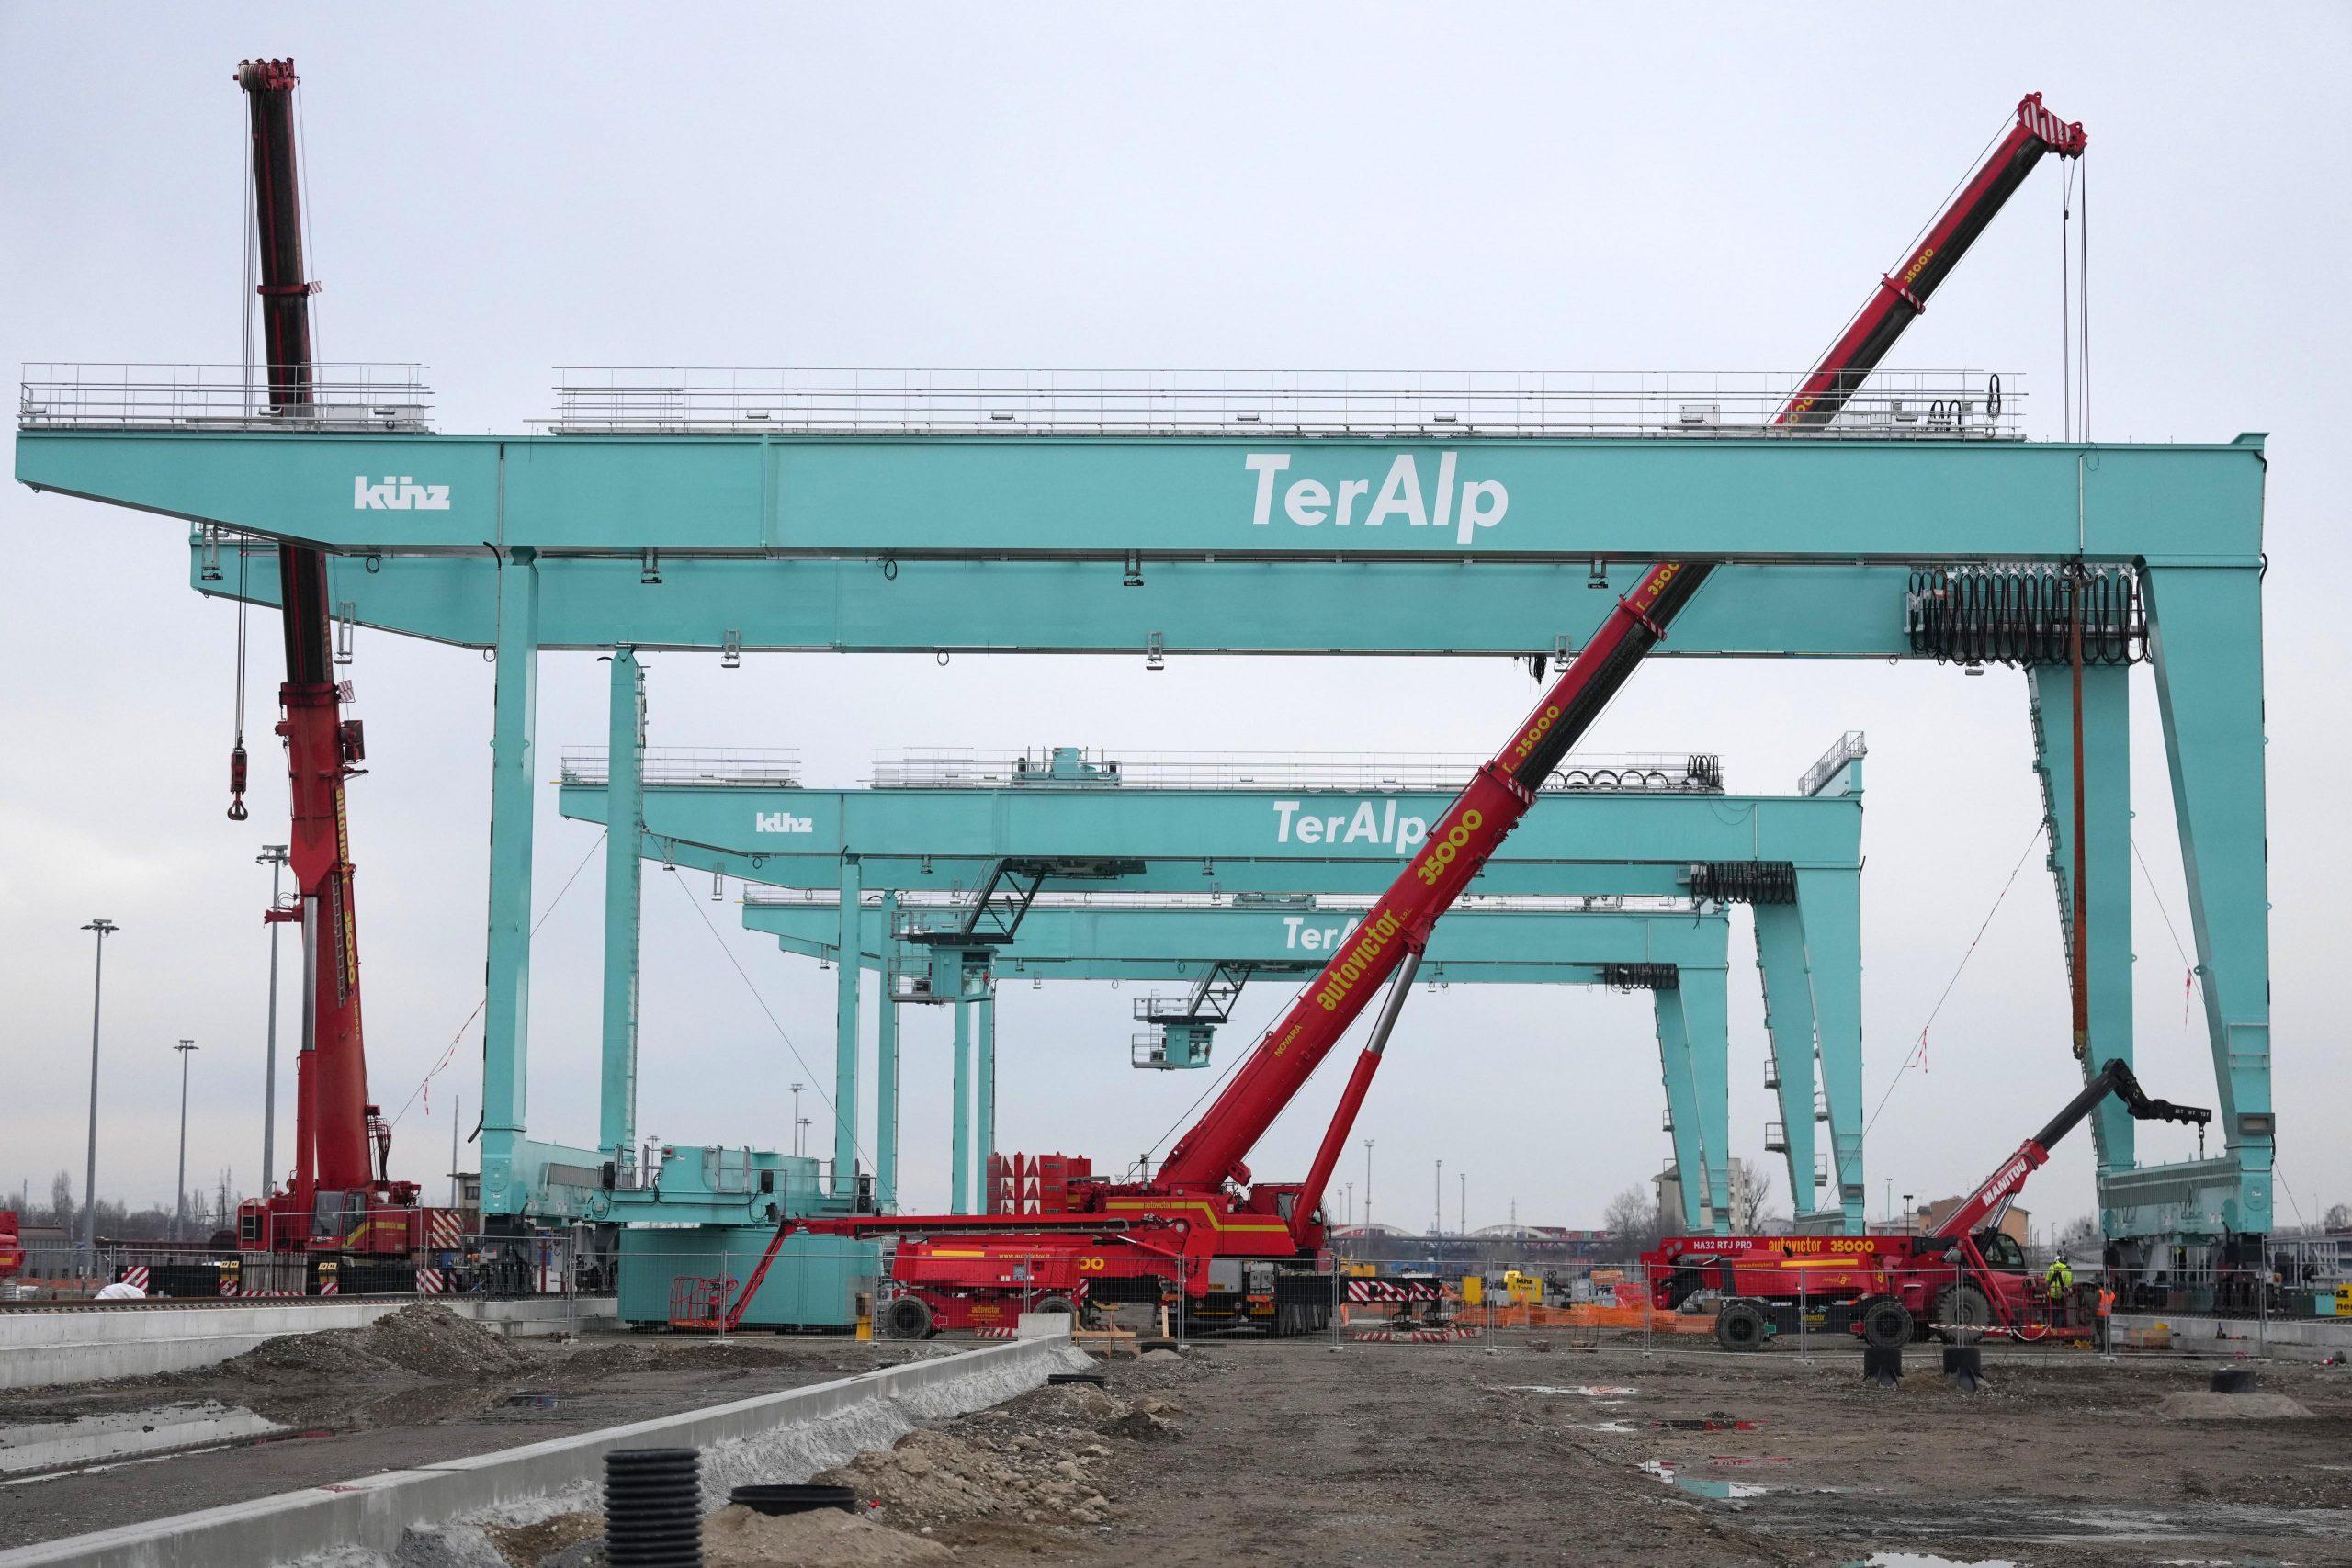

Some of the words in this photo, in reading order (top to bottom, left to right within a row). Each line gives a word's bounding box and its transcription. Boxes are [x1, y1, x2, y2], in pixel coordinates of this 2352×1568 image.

[1904, 248, 1934, 283] 35000
[354, 476, 450, 509] künz
[1245, 451, 1509, 544] TerAlp
[1648, 563, 1680, 595] 3500
[1516, 705, 1560, 758] 35000
[335, 788, 350, 885] autovictr
[756, 812, 813, 833] künz
[1272, 799, 1427, 854] TerAlp
[1317, 908, 1401, 1012] autovictor
[1418, 809, 1484, 886] 35000
[344, 910, 356, 985] 35000
[1283, 917, 1360, 950] TerA
[1273, 1022, 1303, 1057] NOVARA
[1982, 1159, 2027, 1207] MANITOU
[1693, 1241, 1715, 1250] HA32
[1717, 1241, 1733, 1249] RTJ
[1735, 1241, 1753, 1249] PRO
[1768, 1237, 1822, 1253] autovictor
[1830, 1240, 1875, 1253] 35000
